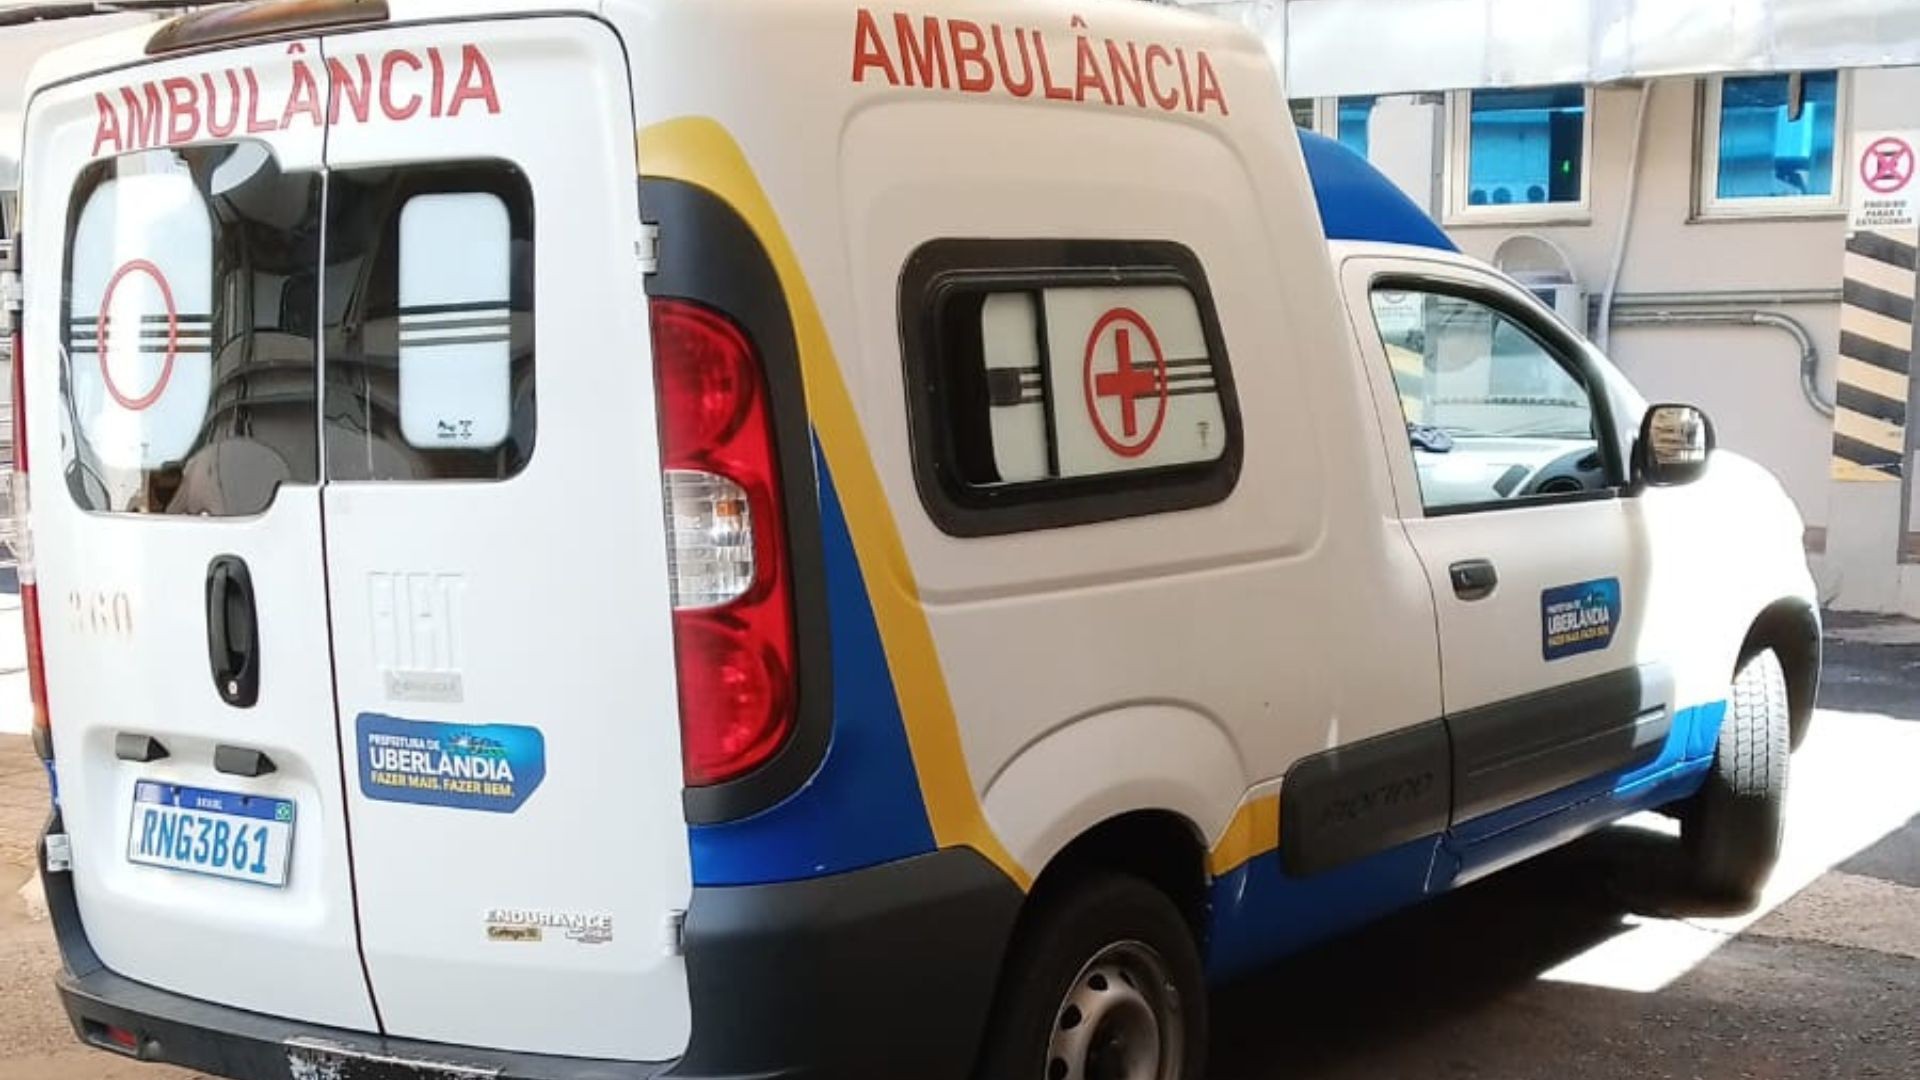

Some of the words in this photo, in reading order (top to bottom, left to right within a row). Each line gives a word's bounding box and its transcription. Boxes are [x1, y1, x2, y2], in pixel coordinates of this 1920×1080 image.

[853, 9, 1229, 116] AMBULÂNCIA
[92, 43, 501, 156] AMBULÂNCIA
[371, 770, 406, 787] FAZER
[443, 778, 482, 794] FAZER
[139, 808, 269, 874] RNG3B61
[484, 907, 613, 930] ENDURANCE
